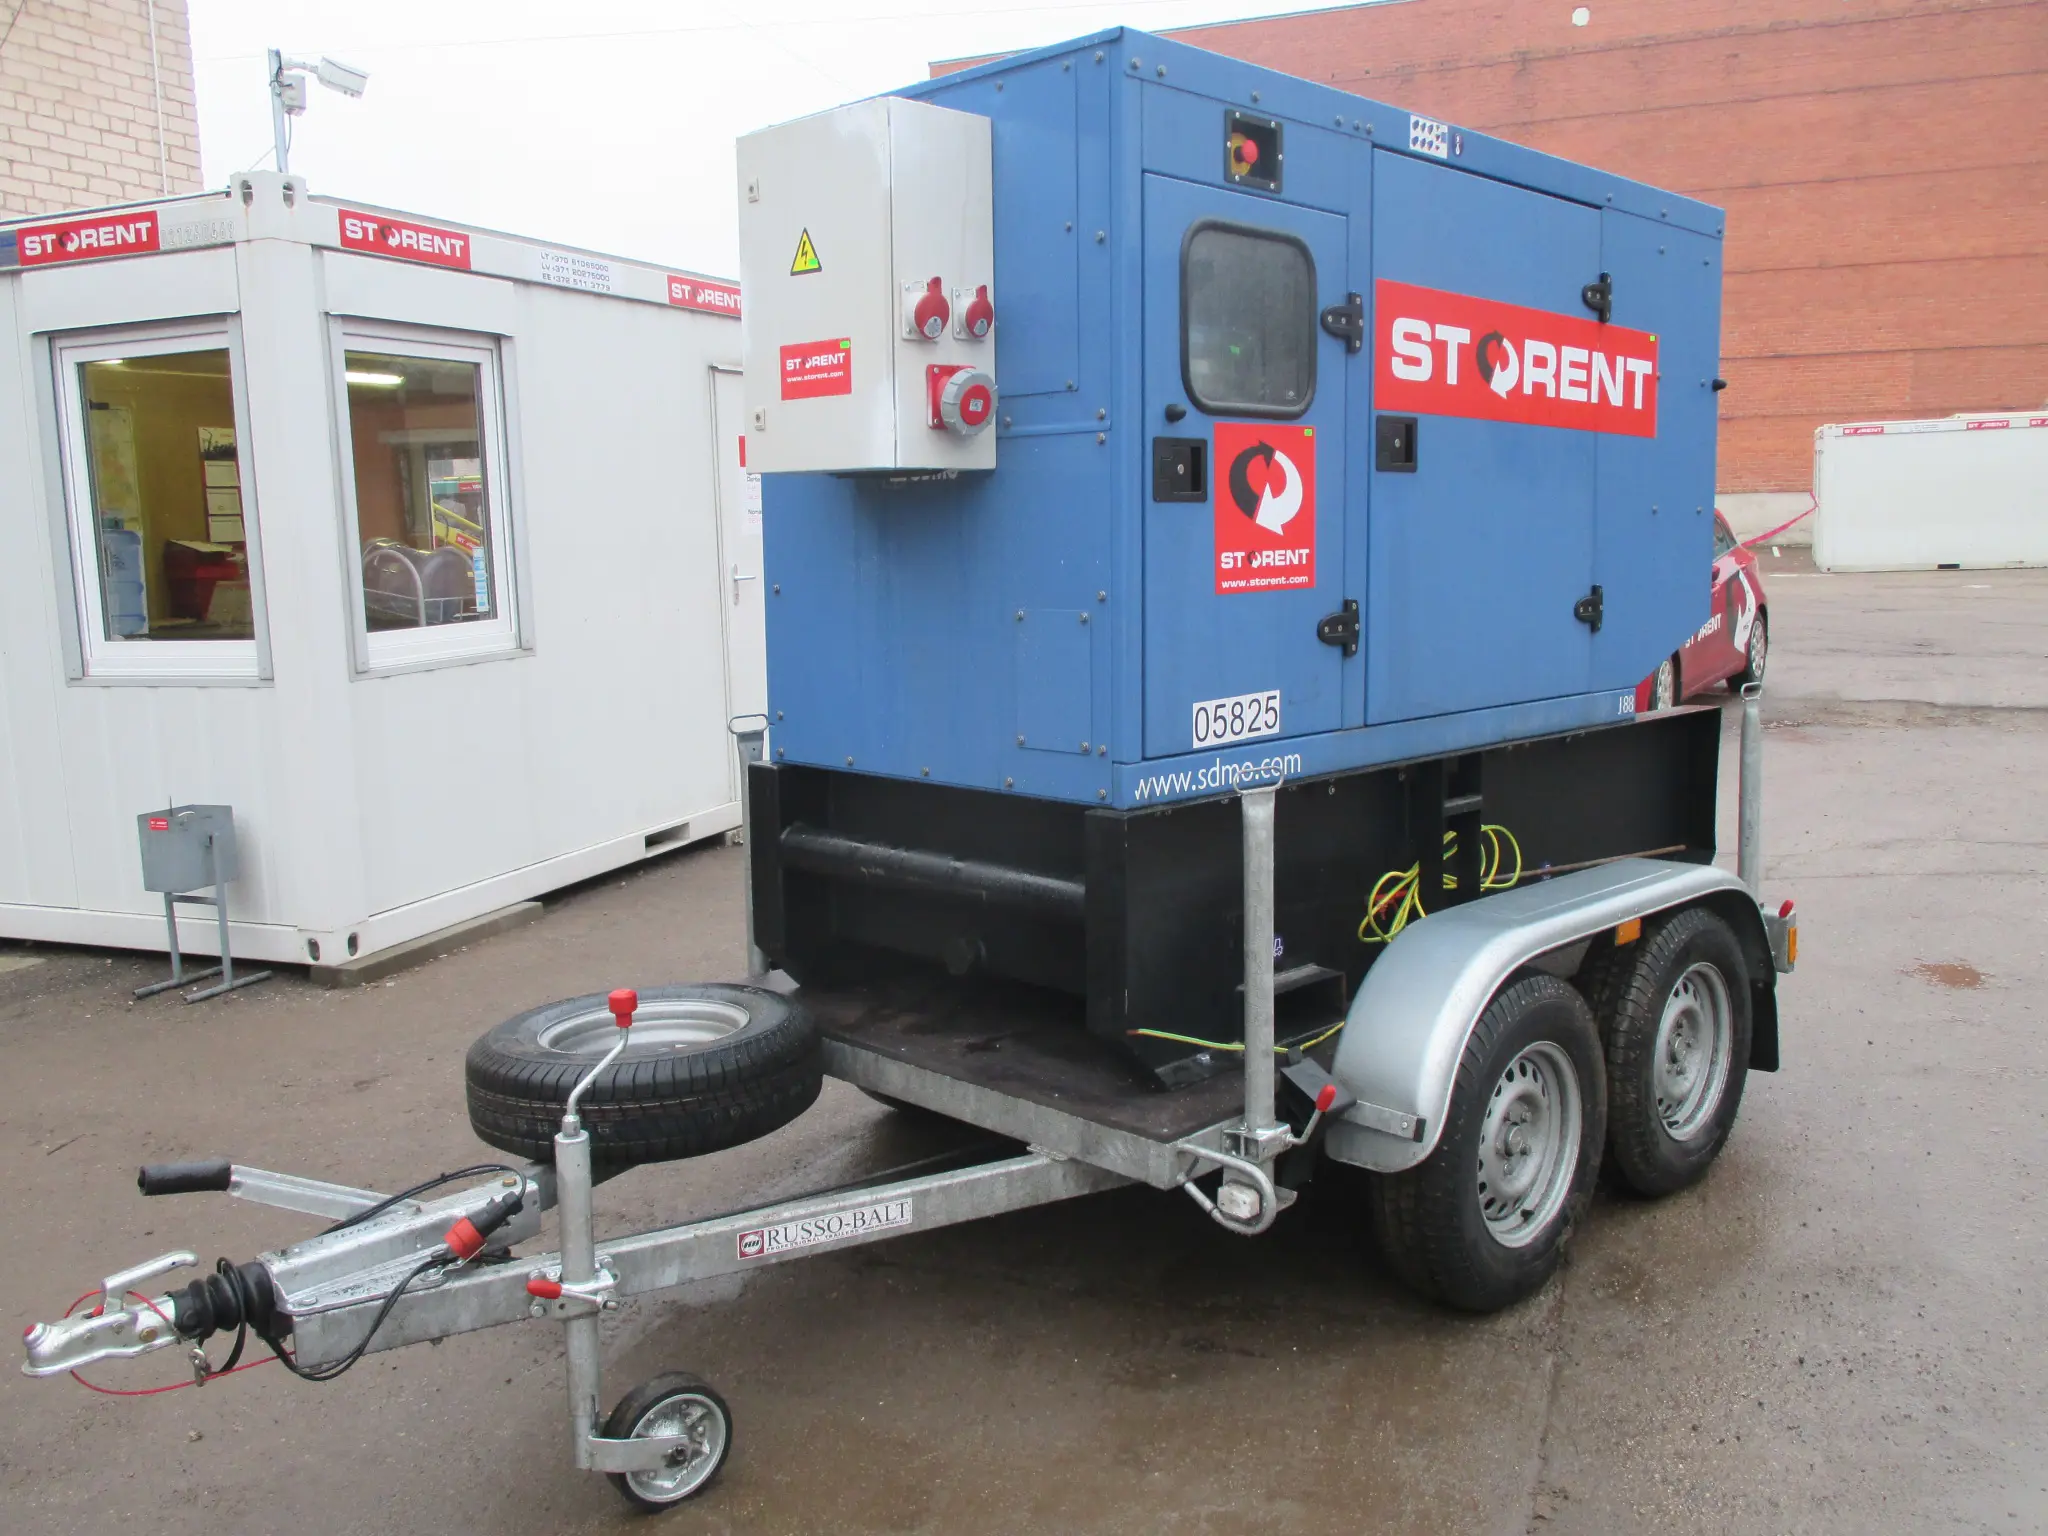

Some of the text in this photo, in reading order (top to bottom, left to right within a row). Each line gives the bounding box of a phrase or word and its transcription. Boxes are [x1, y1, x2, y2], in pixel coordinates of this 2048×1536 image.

[24, 221, 152, 256] STORENT
[345, 218, 464, 257] STORENT
[552, 256, 568, 264] +370
[552, 265, 569, 274] +371
[553, 276, 570, 284] +372
[573, 279, 587, 288] 511
[590, 282, 611, 292] 3779
[786, 353, 845, 370] STORENT
[1391, 317, 1652, 409] STORENT
[786, 371, 844, 382] www.storent.com
[1221, 549, 1310, 569] STORENT
[1221, 576, 1308, 588] www.storent.com
[1617, 696, 1634, 714] J88
[1194, 695, 1278, 742] 05825
[1134, 753, 1301, 801] www.sdmo.com
[767, 1201, 909, 1247] RUSSO-BALT
